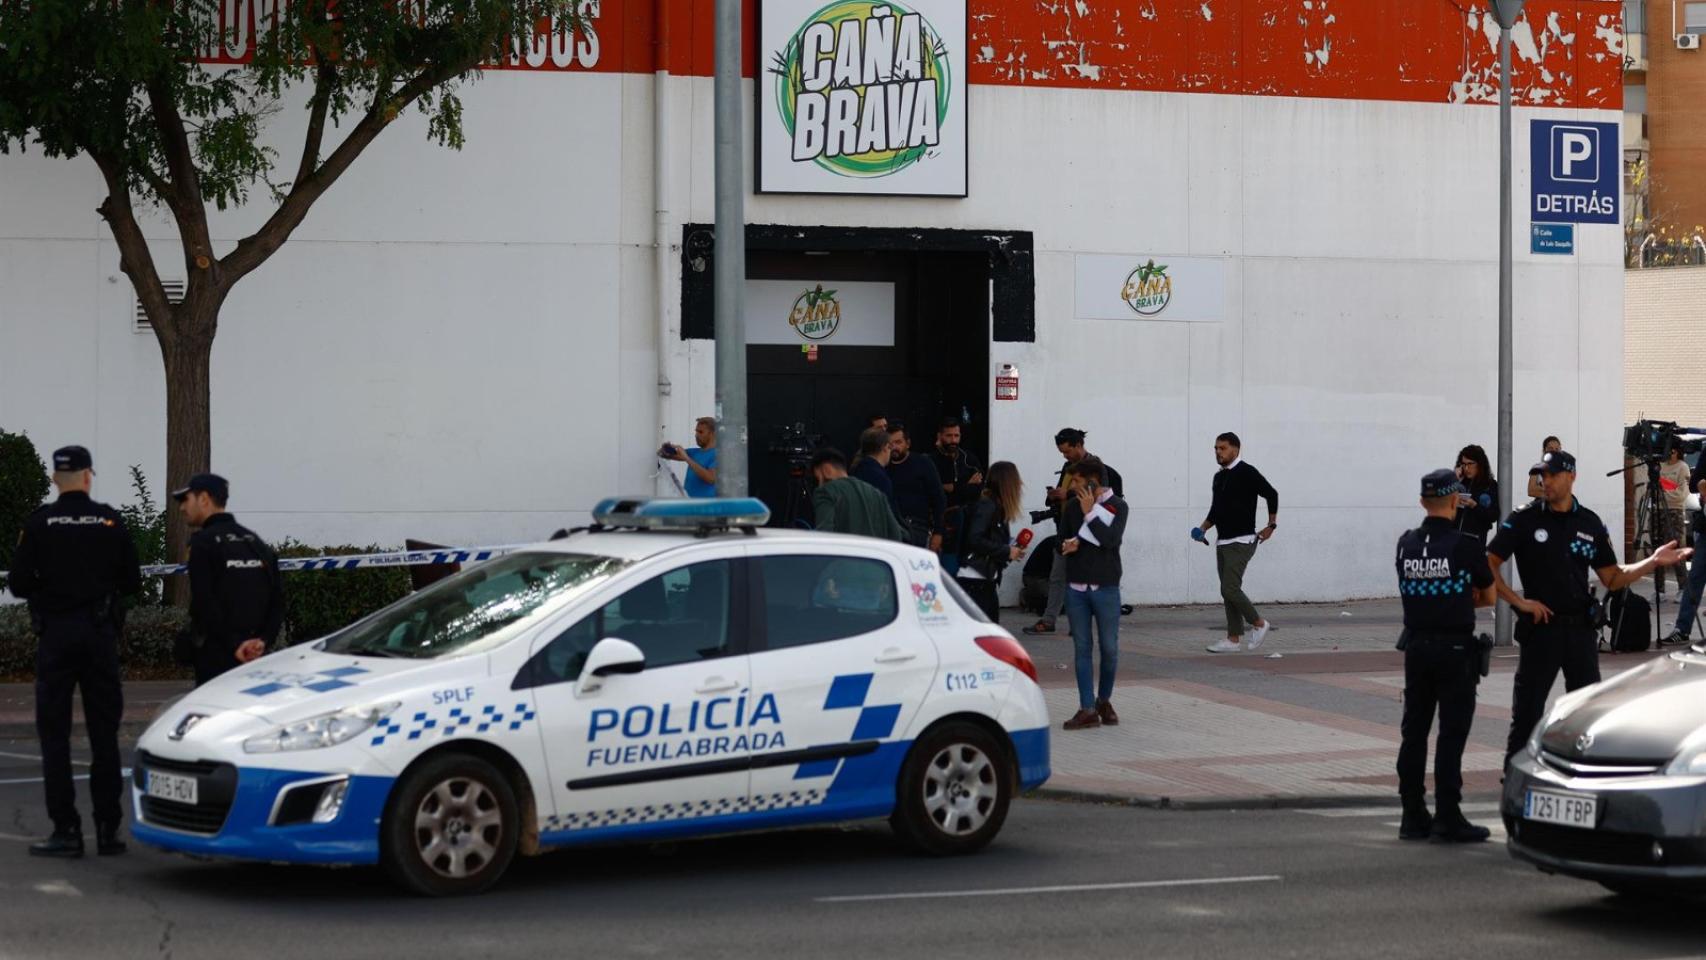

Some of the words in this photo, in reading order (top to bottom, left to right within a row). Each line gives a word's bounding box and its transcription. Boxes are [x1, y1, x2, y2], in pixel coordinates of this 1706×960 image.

[801, 5, 923, 92] CAÑA
[791, 78, 940, 162] BRAVA
[1562, 132, 1592, 175] P
[1536, 190, 1614, 214] DETRÁS
[1136, 295, 1164, 308] BRAVA
[1403, 558, 1450, 571] POLICIA
[432, 686, 474, 705] SPLF
[955, 673, 978, 689] 112
[587, 688, 781, 743] POLICÍA
[587, 731, 786, 767] FUENLABRADA
[1532, 794, 1560, 819] 1251
[1565, 797, 1593, 824] FBP
